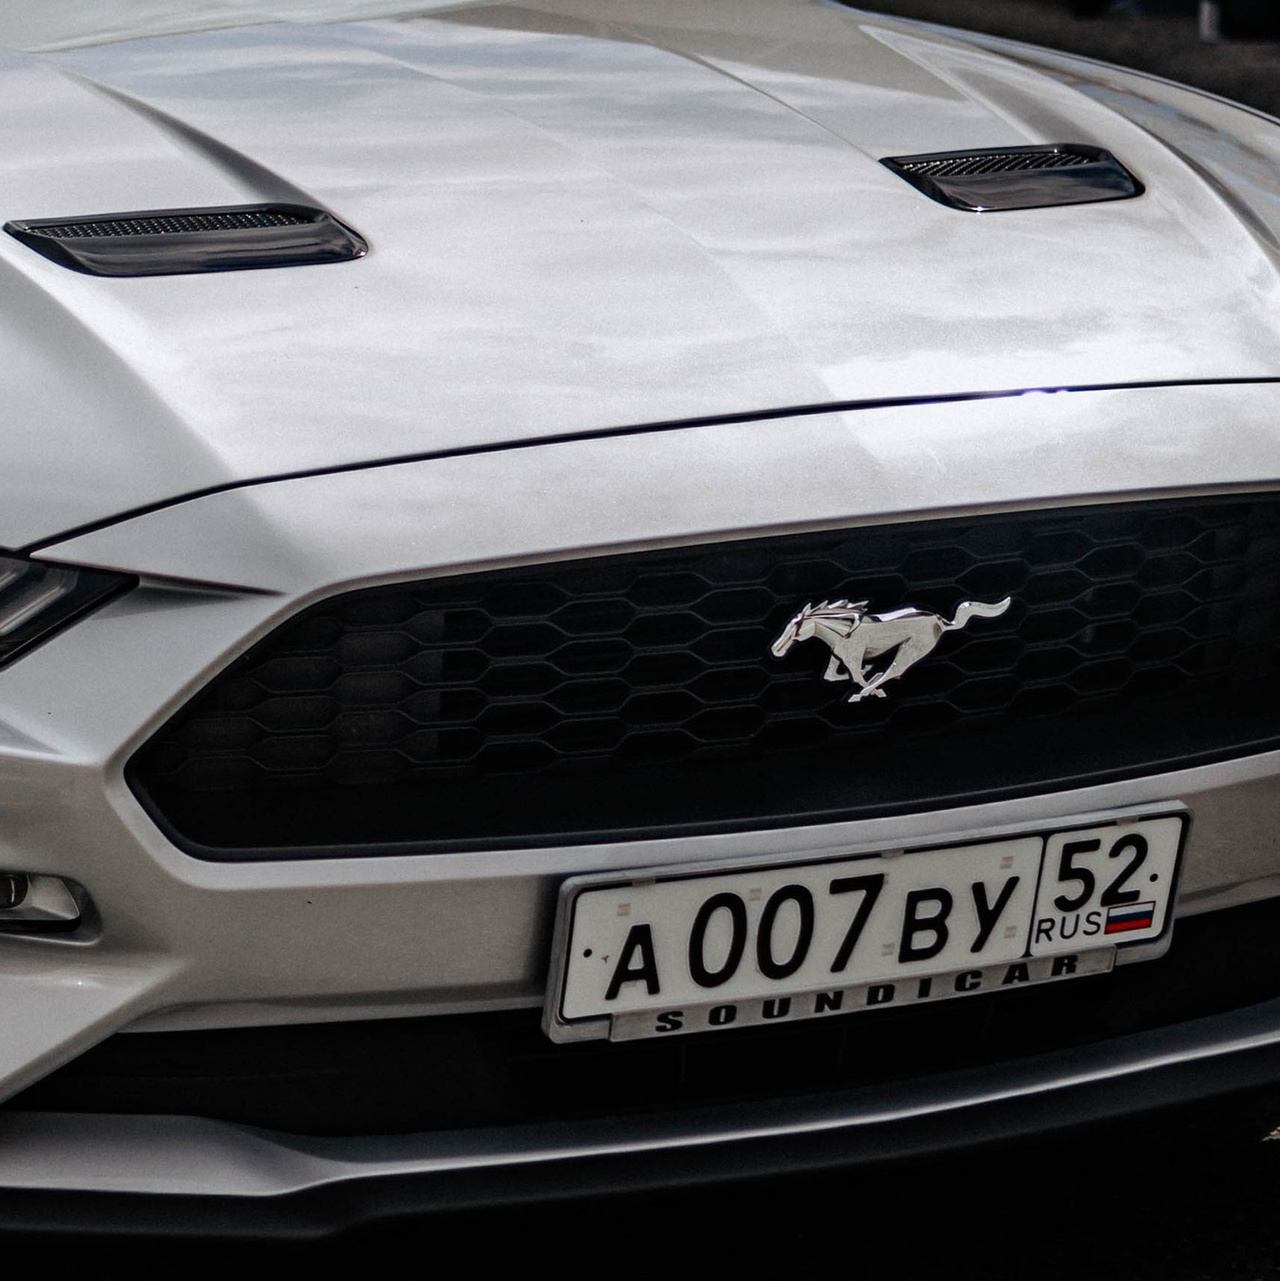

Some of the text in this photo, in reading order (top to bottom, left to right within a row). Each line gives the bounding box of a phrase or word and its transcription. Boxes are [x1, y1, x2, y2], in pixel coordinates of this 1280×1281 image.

[1053, 833, 1149, 913] 52
[1035, 911, 1102, 944] RUS
[655, 955, 1078, 1033] SOUNDICAR
